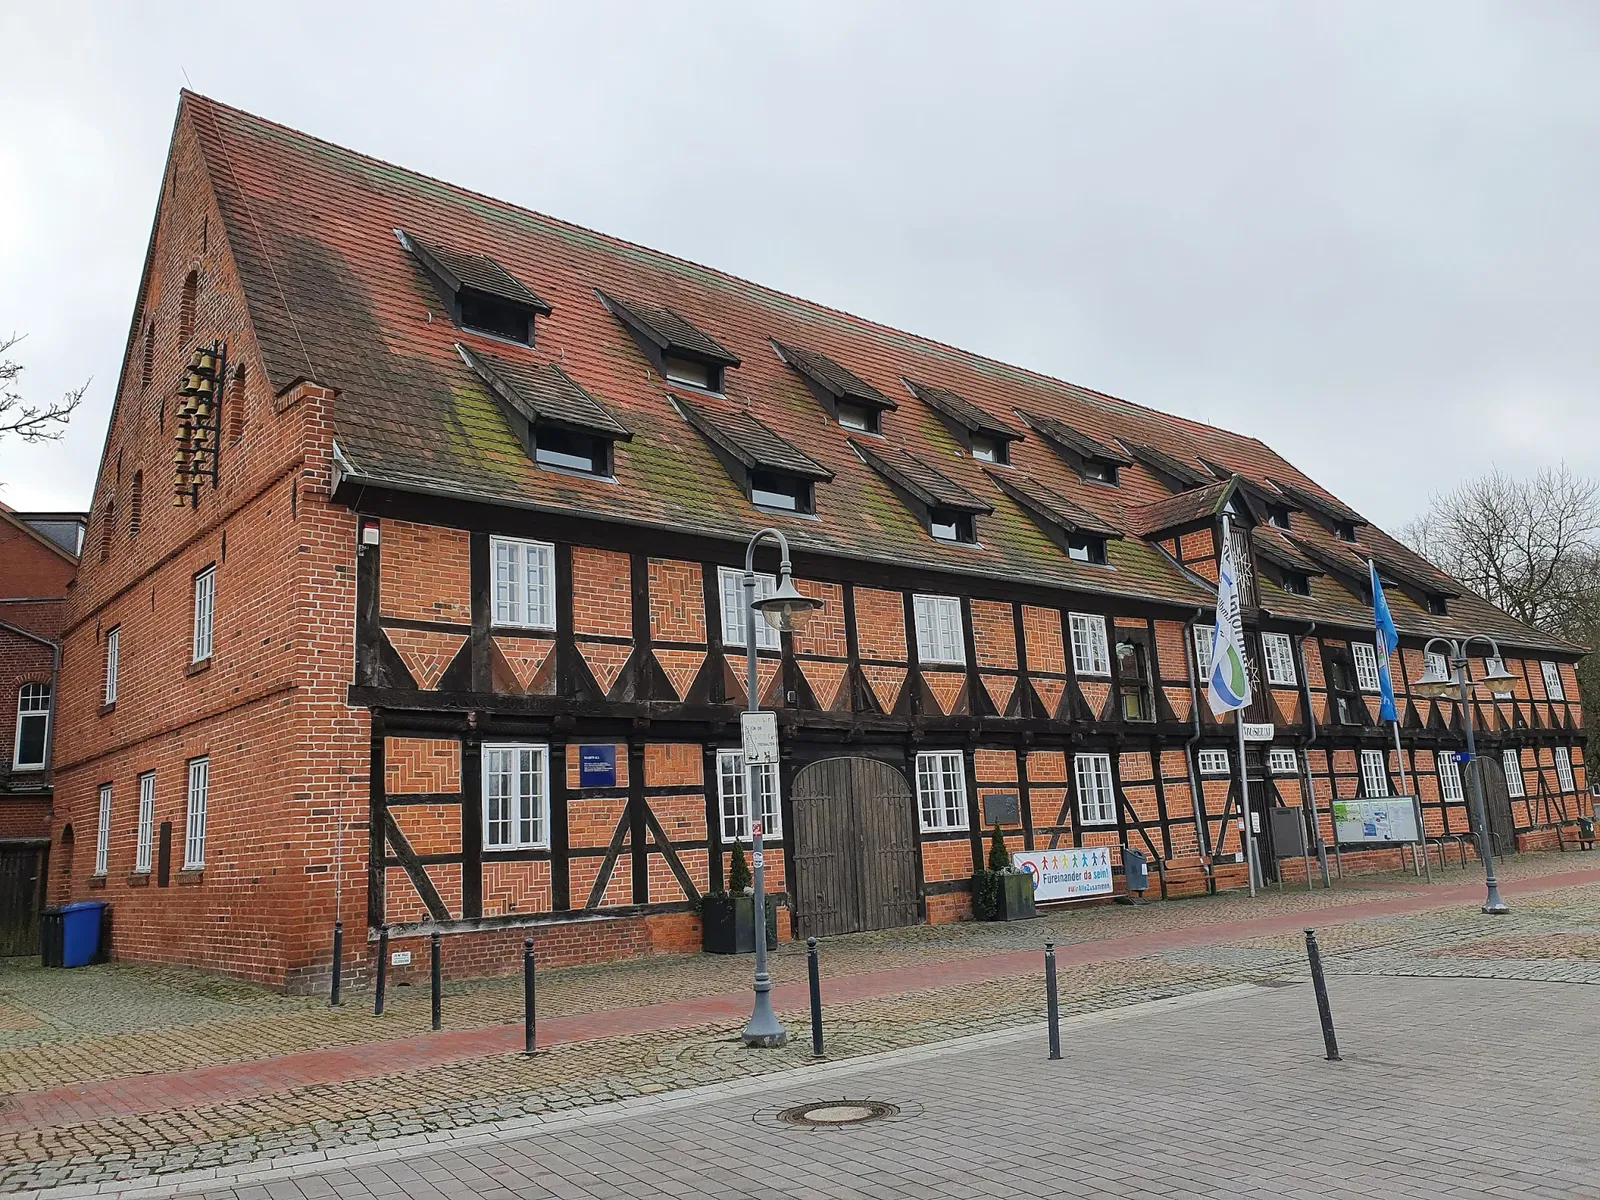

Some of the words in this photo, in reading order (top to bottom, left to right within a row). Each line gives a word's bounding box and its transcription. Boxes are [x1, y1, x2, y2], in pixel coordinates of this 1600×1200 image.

[1243, 726, 1271, 737] MUSEUM
[1043, 872, 1082, 884] Füreinander
[1084, 870, 1092, 880] da
[1093, 868, 1109, 880] sein!
